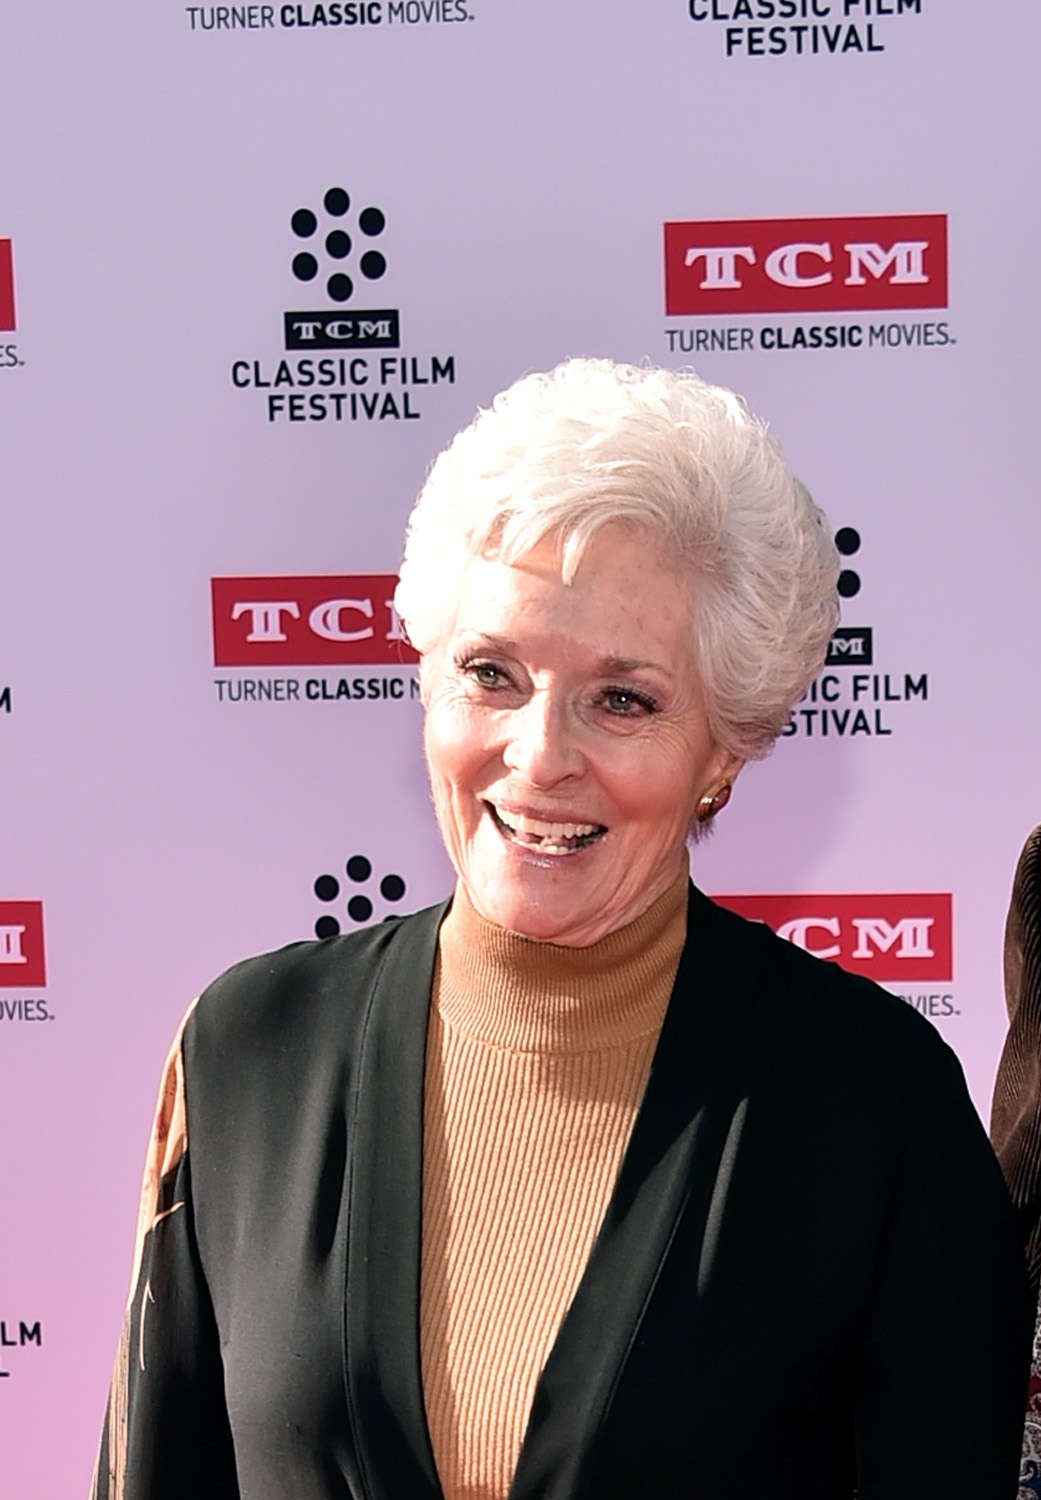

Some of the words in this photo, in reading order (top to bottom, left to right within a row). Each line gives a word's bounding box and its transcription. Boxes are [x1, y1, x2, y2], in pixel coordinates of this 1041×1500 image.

[186, 5, 275, 30] TURNER
[280, 2, 382, 27] CLASSIC
[726, 23, 885, 57] FESTIVAL
[685, 241, 930, 290] TCM
[292, 320, 392, 340] TCM
[665, 328, 755, 353] TURNER
[759, 324, 864, 350] CLASSIC
[231, 358, 369, 388] CLASSIC
[379, 356, 456, 385] FILM
[267, 392, 422, 422] FESTIVAL
[214, 679, 300, 702] TURNER
[305, 677, 404, 701] CLASSIC
[852, 673, 929, 703] FILM
[781, 708, 893, 738] STIVAL
[776, 917, 935, 960] CM
[0, 1321, 42, 1347] LM
